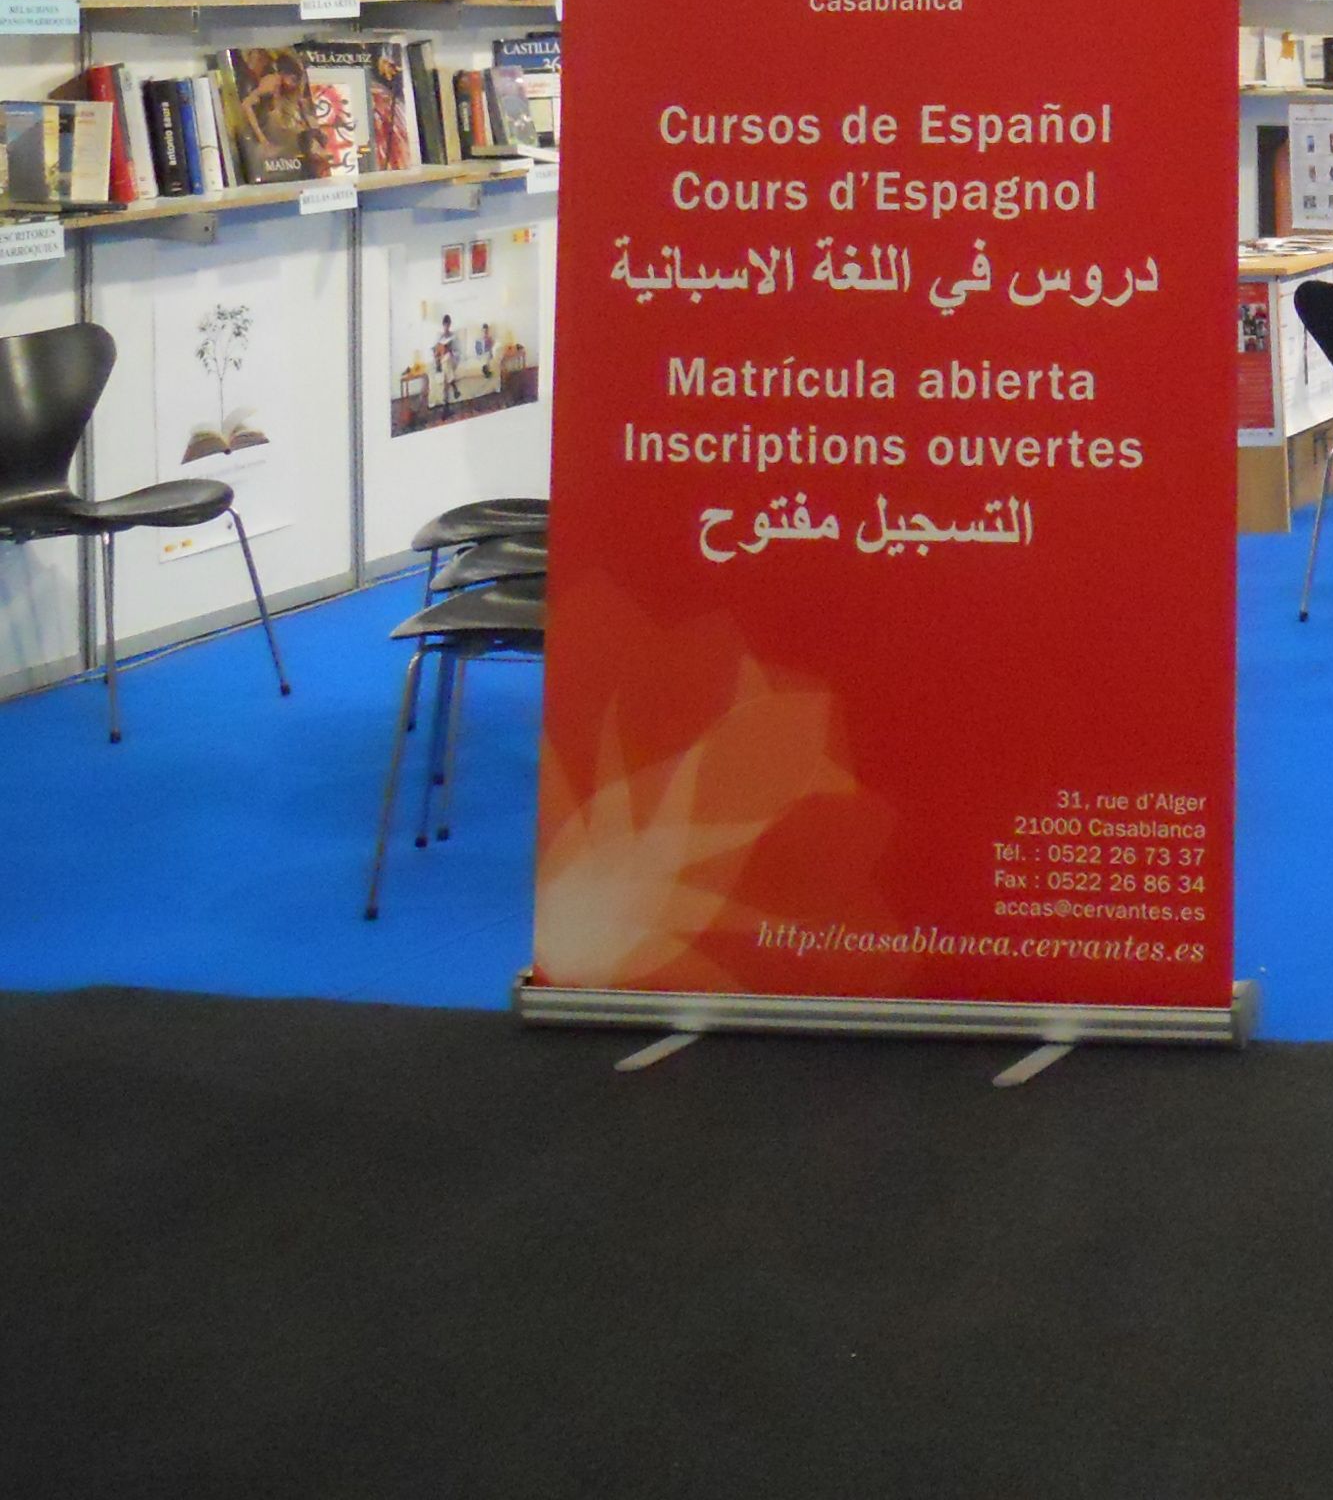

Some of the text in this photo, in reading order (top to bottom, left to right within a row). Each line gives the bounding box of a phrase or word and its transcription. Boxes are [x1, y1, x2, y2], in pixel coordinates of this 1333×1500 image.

[503, 42, 560, 55] CASTILLA
[160, 101, 177, 166] antonio saura
[659, 103, 1112, 152] Cursos de Español
[672, 171, 808, 211] Cours
[610, 235, 1159, 317] دروس في اللغة الاسبانية
[668, 357, 1095, 401] Matrícula abierta
[624, 423, 1144, 472] Inscriptions ouvertes
[698, 491, 1033, 562] التسجيل مفتوح
[1097, 794, 1128, 810] rue
[1015, 816, 1206, 840] 21000 Casablanca
[994, 843, 1027, 863] Tél.
[1047, 846, 1101, 865] 0522
[1109, 846, 1136, 865] 26
[1145, 847, 1170, 866] 73
[1178, 848, 1206, 867] 37
[994, 870, 1026, 889] Fax
[1047, 872, 1101, 892] 0522
[1109, 874, 1136, 893] 26
[1143, 875, 1170, 894] 86
[1178, 876, 1206, 894] 34
[994, 900, 1206, 922] accas@cervantes.es
[757, 921, 1205, 963] http://casablanca.cervantes.es
